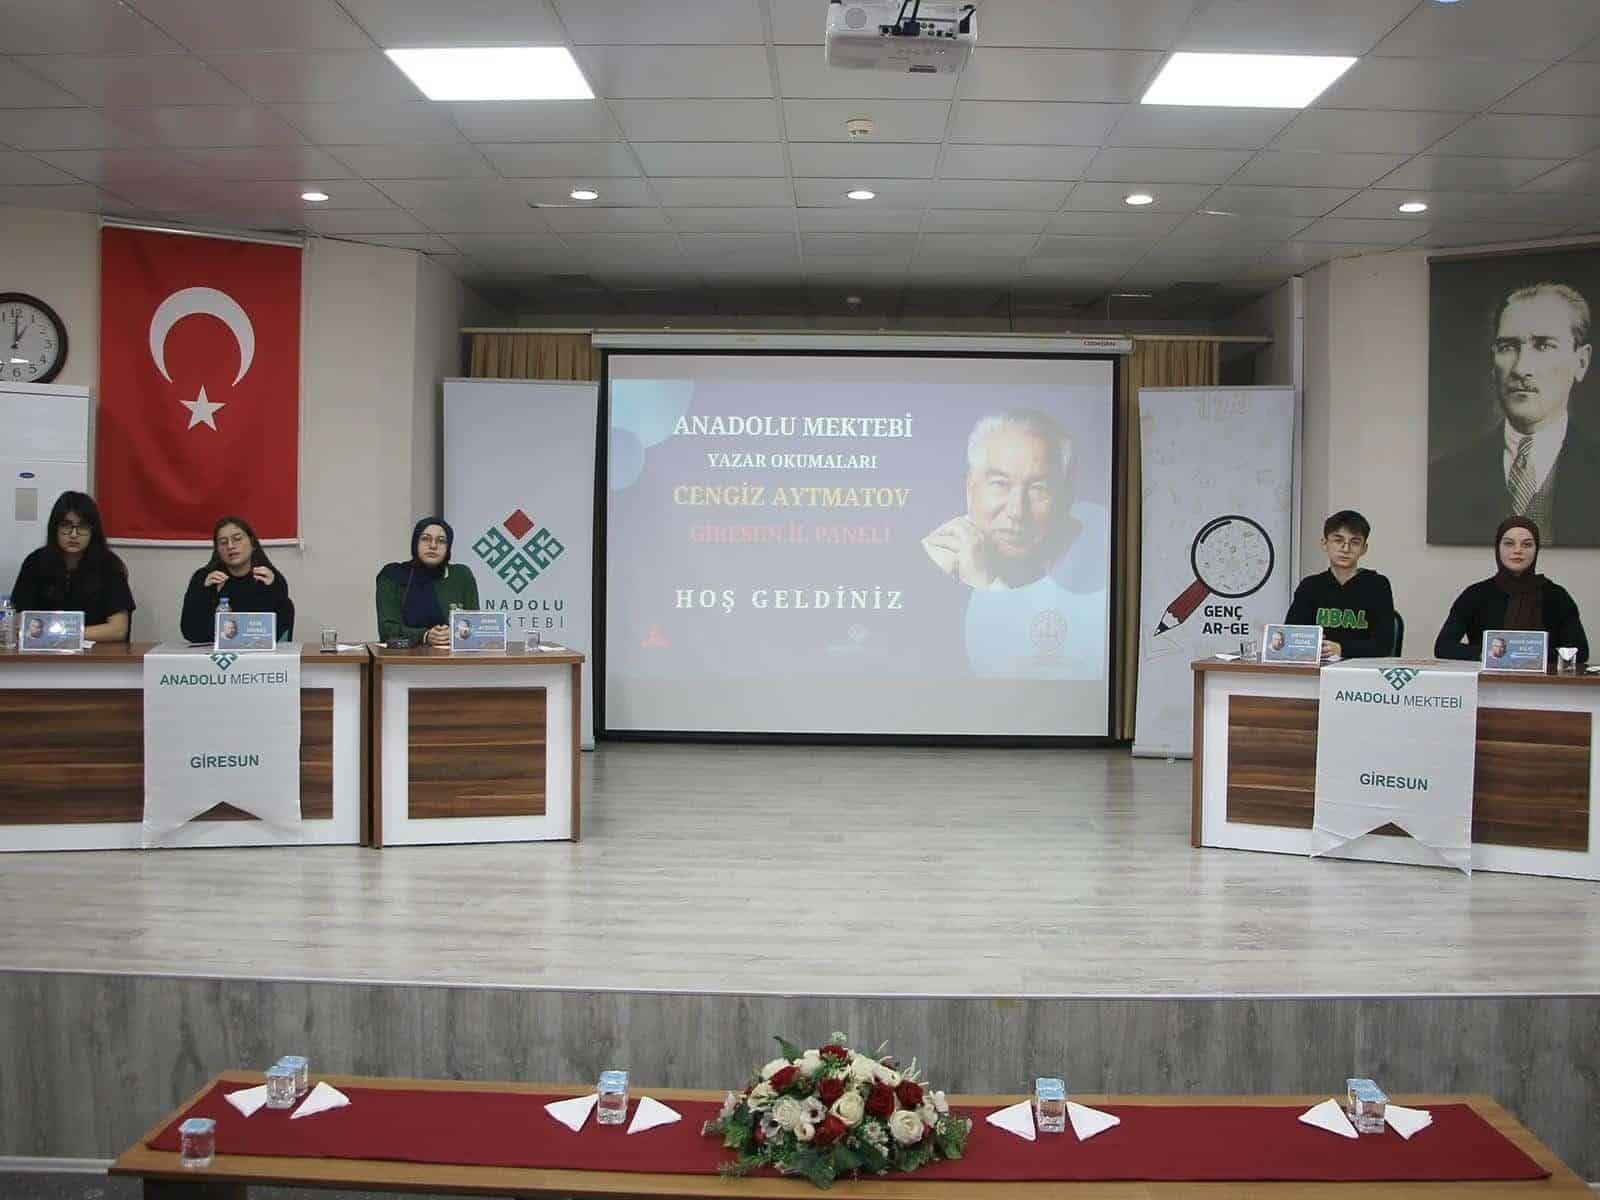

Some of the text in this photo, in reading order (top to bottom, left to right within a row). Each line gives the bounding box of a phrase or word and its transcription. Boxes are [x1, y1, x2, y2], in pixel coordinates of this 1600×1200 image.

[672, 412, 913, 438] ANADOLU MEKTEBİ
[707, 453, 879, 469] YAZAR OKUMALARI
[673, 482, 912, 508] CENGİZ AYTMATOV
[485, 599, 564, 611] NADOLU
[675, 585, 903, 614] HOŞ GELDİNİZ
[1204, 605, 1244, 621] GENÇ
[1316, 607, 1369, 630] HBAL
[1202, 622, 1249, 636] AR-GE
[159, 670, 288, 686] ANADOLU MEKTEBİ
[1335, 690, 1462, 709] ANADOLU MEKTEBİ
[190, 752, 260, 769] GİRESUN
[1359, 771, 1429, 791] GİRESUN
